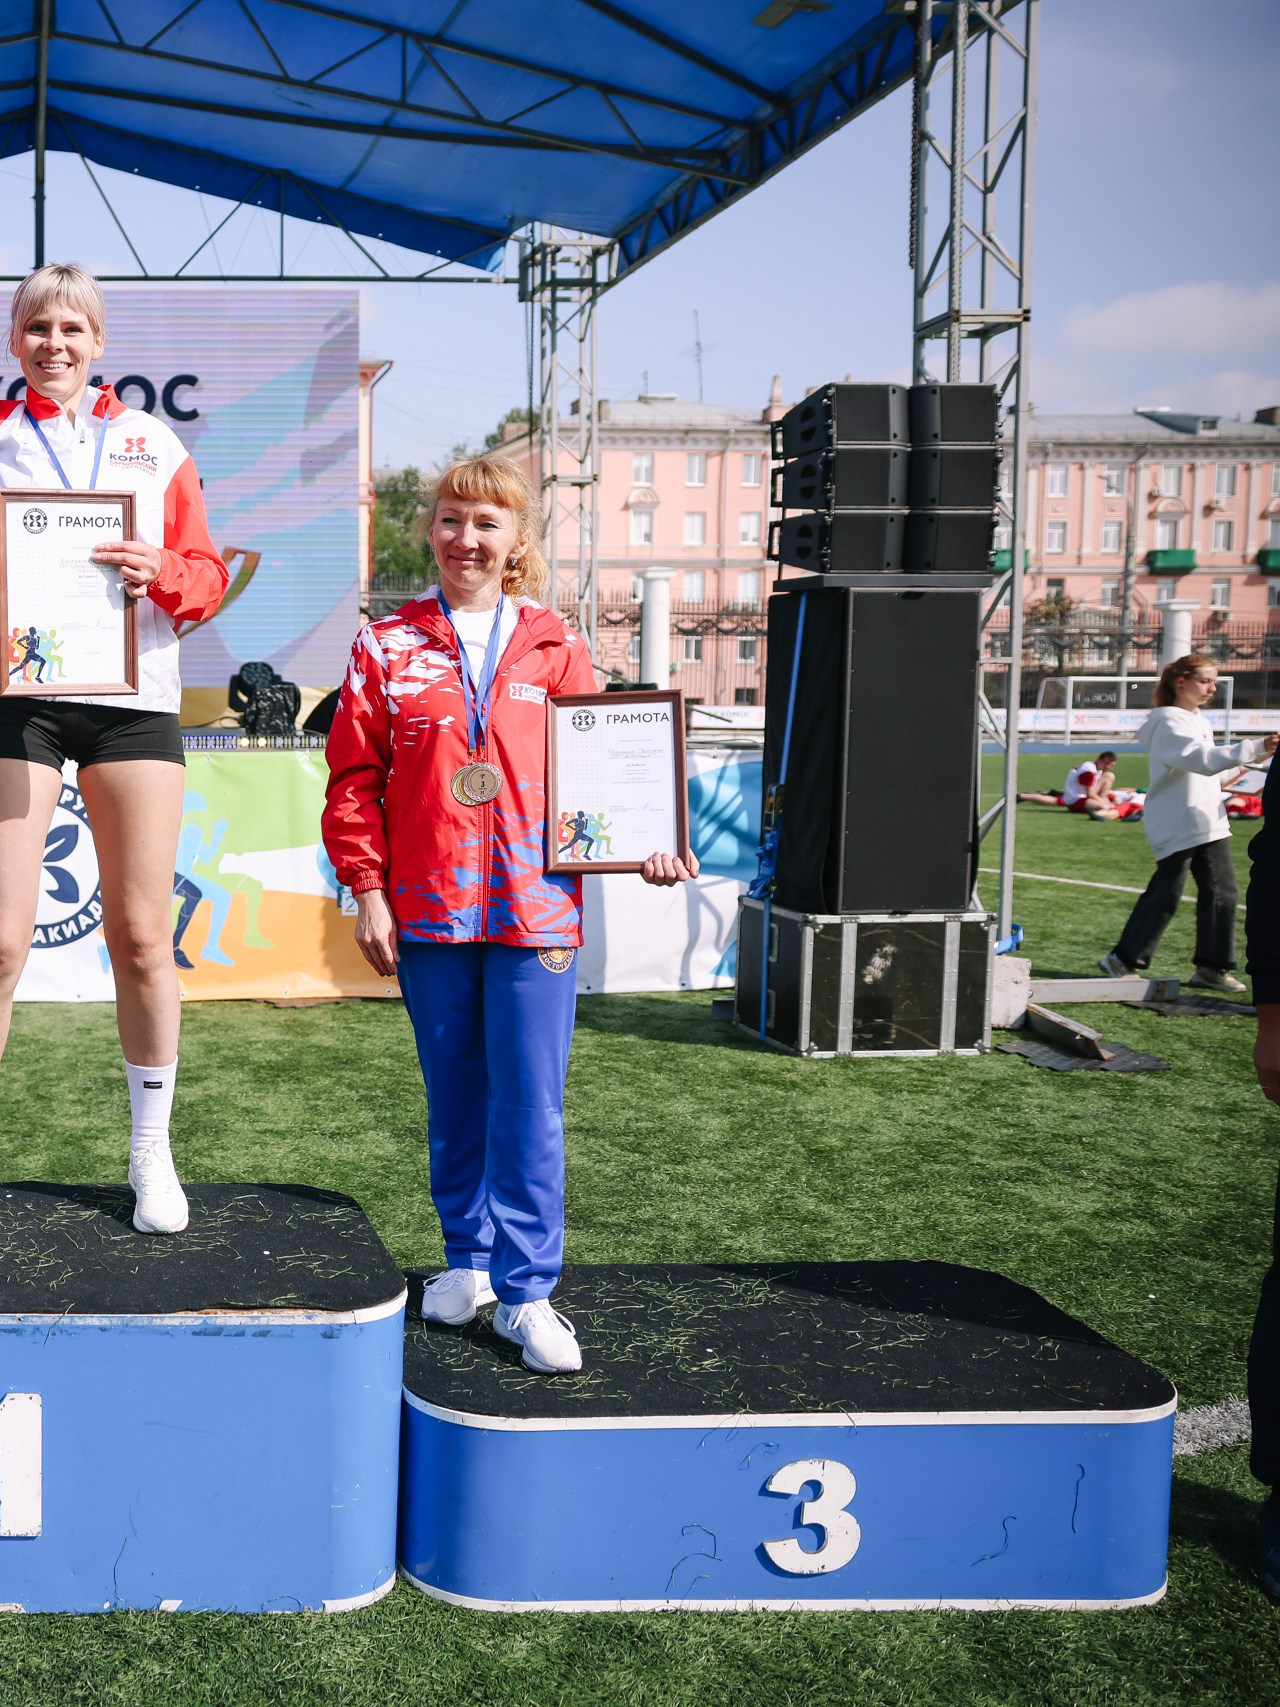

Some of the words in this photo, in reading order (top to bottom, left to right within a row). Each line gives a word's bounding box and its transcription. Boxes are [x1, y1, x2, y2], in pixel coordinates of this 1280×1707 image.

[109, 453, 158, 466] КОМОС
[58, 516, 122, 528] ГРАМОТА
[606, 712, 670, 725] ГРАМОТА
[762, 1458, 862, 1575] 3
